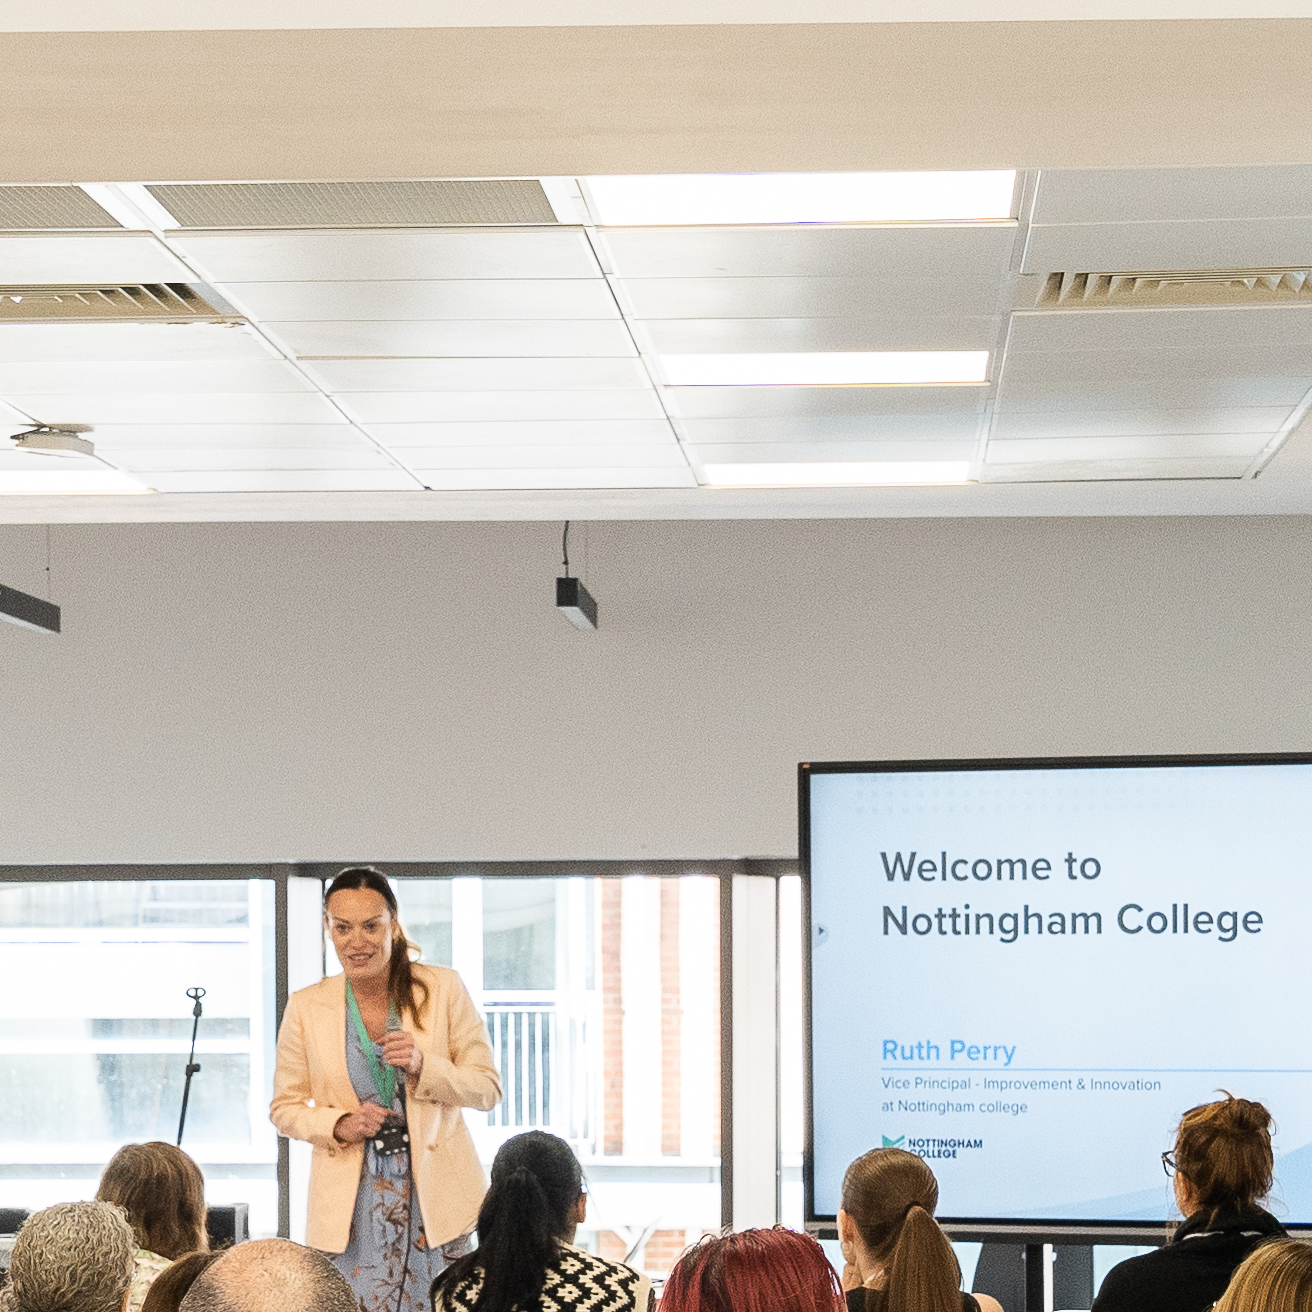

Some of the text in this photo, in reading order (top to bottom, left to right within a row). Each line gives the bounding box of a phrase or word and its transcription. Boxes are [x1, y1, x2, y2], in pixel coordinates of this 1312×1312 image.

[880, 851, 1102, 882] Welcome to
[882, 902, 1264, 943] Nottingham College
[882, 1039, 1017, 1067] Ruth Perry
[881, 1077, 910, 1090] Vice
[915, 1077, 971, 1092] Principal
[984, 1078, 1073, 1092] Improvement
[1076, 1078, 1086, 1090] &
[1090, 1078, 1162, 1091] Innovation
[881, 1100, 1028, 1116] at Nottingham college
[908, 1138, 983, 1148] NOTTINGHAM
